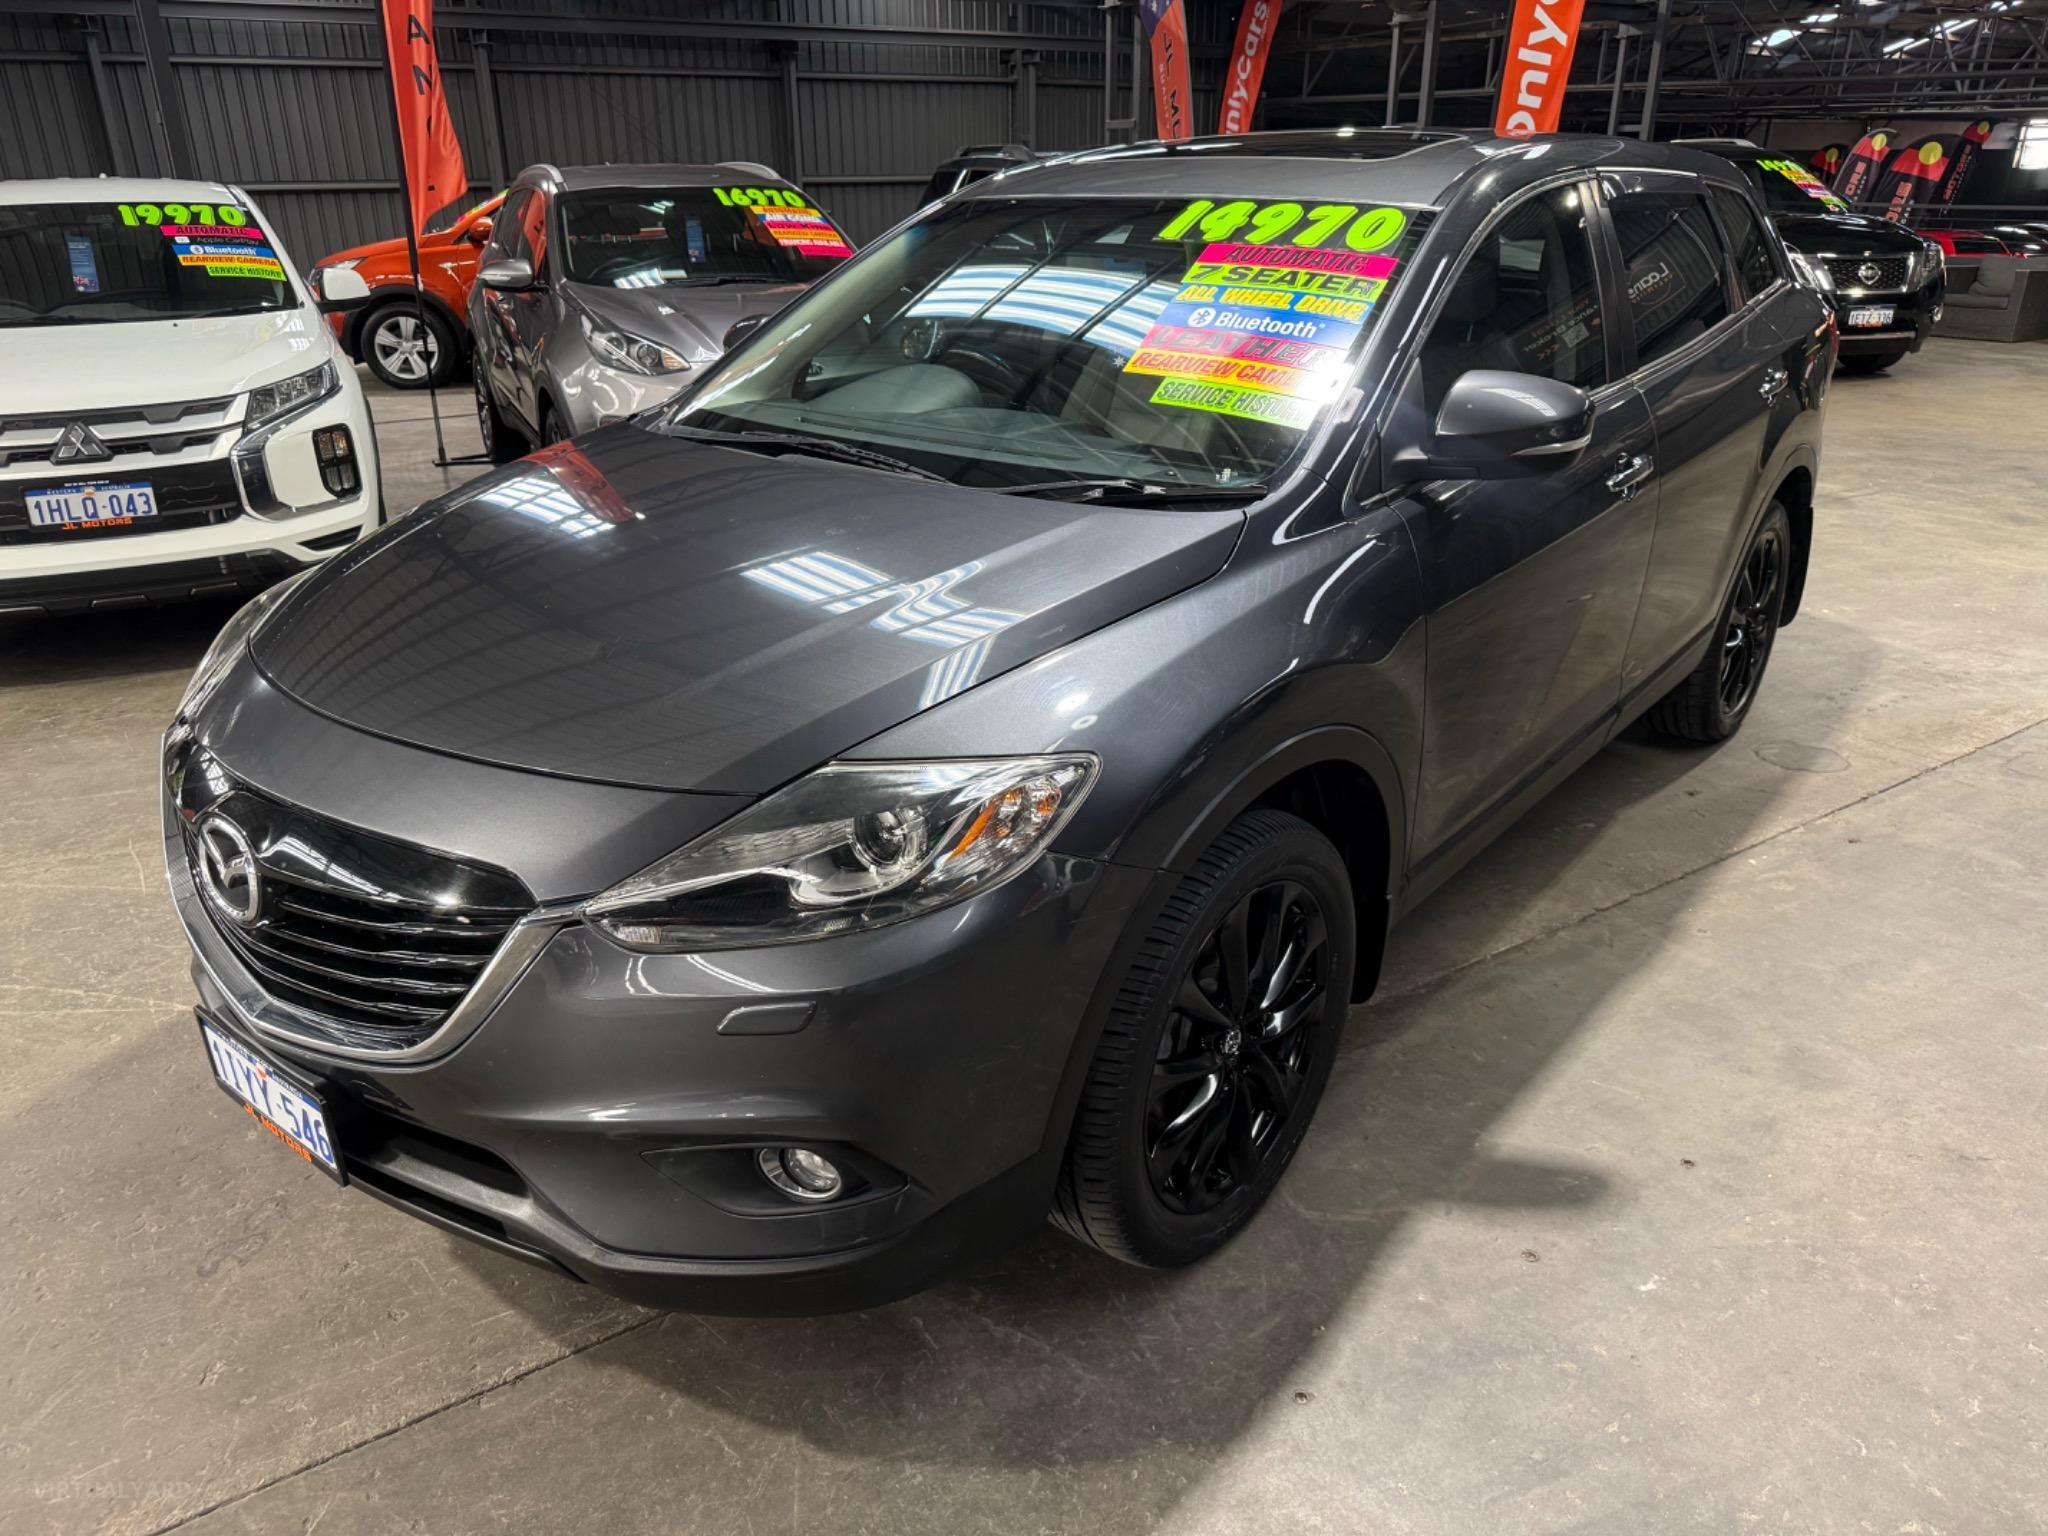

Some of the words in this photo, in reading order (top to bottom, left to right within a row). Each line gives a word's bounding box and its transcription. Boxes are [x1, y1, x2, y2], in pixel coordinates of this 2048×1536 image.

[1505, 0, 1568, 134] only
[713, 188, 806, 207] 16970
[118, 204, 247, 226] 19970
[1158, 200, 1406, 252] 14970
[176, 227, 248, 235] AUTOMATIC
[182, 256, 234, 264] REARVIEW
[237, 257, 278, 267] CAMERA
[204, 246, 257, 256] Bluetooth
[1225, 246, 1370, 274] AUTOMATIC
[209, 266, 246, 275] SERVICE
[1190, 264, 1224, 281] 7
[1222, 265, 1379, 298] SEATER
[1175, 285, 1219, 302] ALL
[1219, 287, 1294, 310] WHEEL
[1294, 294, 1371, 320] DRIVE
[1214, 312, 1318, 339] Bluetooth
[1133, 352, 1236, 376] REARVIEW
[1157, 381, 1234, 408] SERVICE
[82, 517, 132, 528] MOTORS
